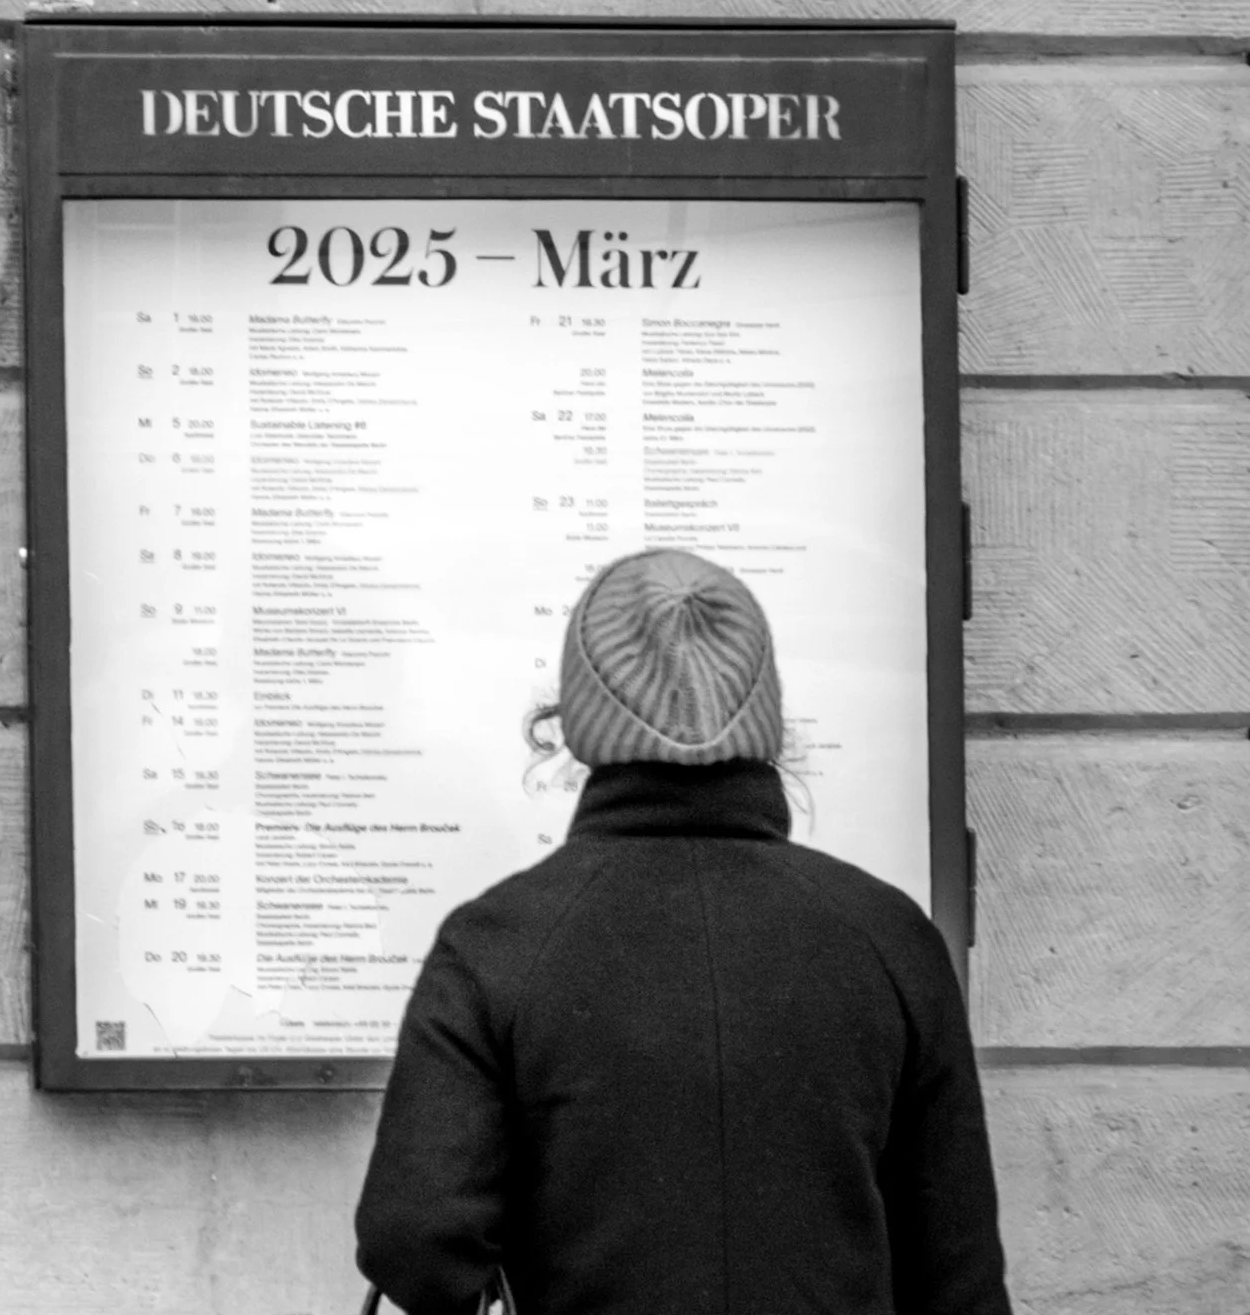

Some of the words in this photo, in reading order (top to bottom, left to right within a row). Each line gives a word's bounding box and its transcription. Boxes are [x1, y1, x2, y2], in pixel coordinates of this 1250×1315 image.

[141, 90, 456, 139] DEUTSCHE
[473, 91, 841, 141] STAATSOPER
[266, 225, 458, 287] 2025
[531, 229, 703, 290] März
[136, 311, 152, 323] Sa
[559, 315, 572, 327] 21
[138, 364, 153, 375] So
[532, 410, 546, 421] Sa
[558, 410, 573, 422] 22
[138, 418, 152, 427] Mi
[138, 452, 156, 464] Do
[559, 495, 575, 508] 23
[139, 505, 150, 516] Fr
[140, 549, 155, 560] Sa
[140, 603, 157, 613] So
[534, 605, 553, 616] Mo
[141, 689, 154, 700] Di
[141, 714, 154, 726] Fr
[142, 768, 158, 780] Sa
[144, 872, 163, 883] Mo
[144, 899, 158, 909] Mi
[145, 951, 162, 962] Do
